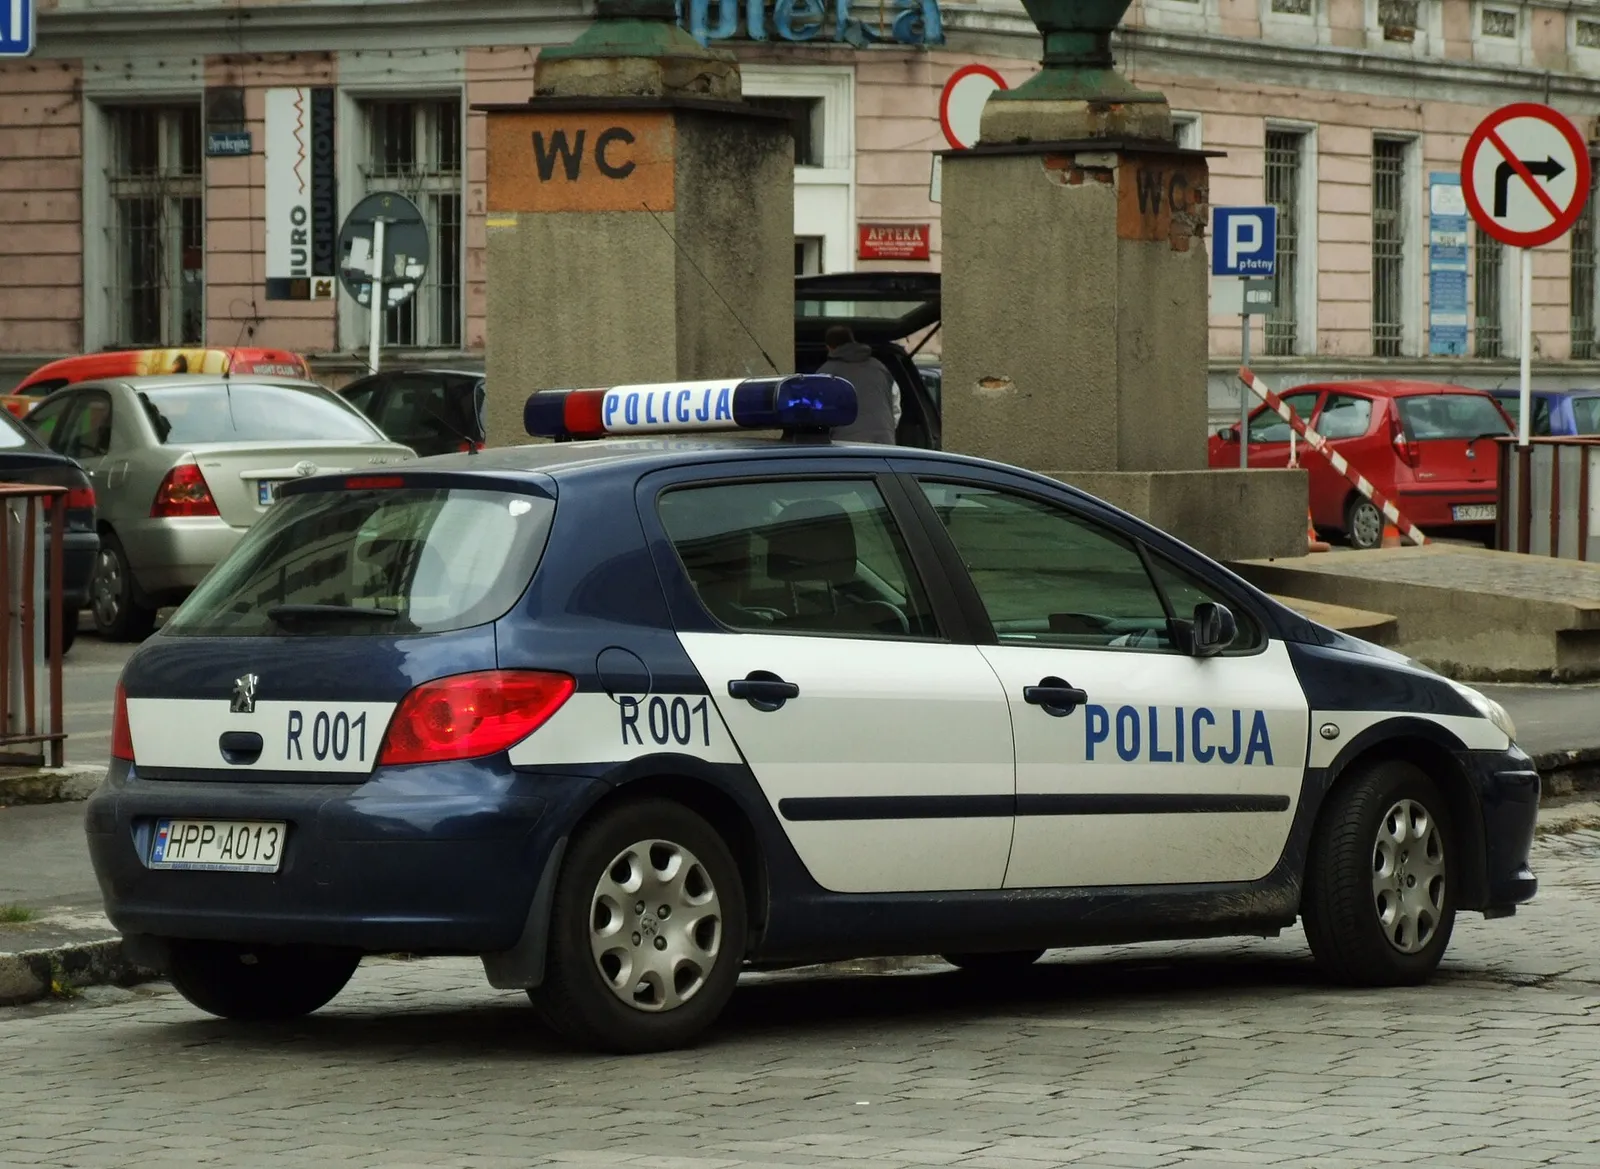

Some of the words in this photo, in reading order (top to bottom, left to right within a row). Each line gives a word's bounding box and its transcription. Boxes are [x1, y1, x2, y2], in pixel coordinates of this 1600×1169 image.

[675, 0, 946, 48] pteka
[531, 126, 636, 182] WC
[290, 205, 307, 297] IURO
[868, 228, 921, 240] APTEKA
[1227, 214, 1263, 268] P
[1239, 259, 1273, 271] płatny
[605, 388, 732, 426] POLICJA
[287, 710, 303, 760] R
[313, 711, 366, 761] 001
[619, 696, 644, 745] R
[648, 696, 710, 746] 001
[1085, 704, 1274, 765] POLICJA
[166, 824, 216, 858] HPP
[220, 825, 278, 860] A013
